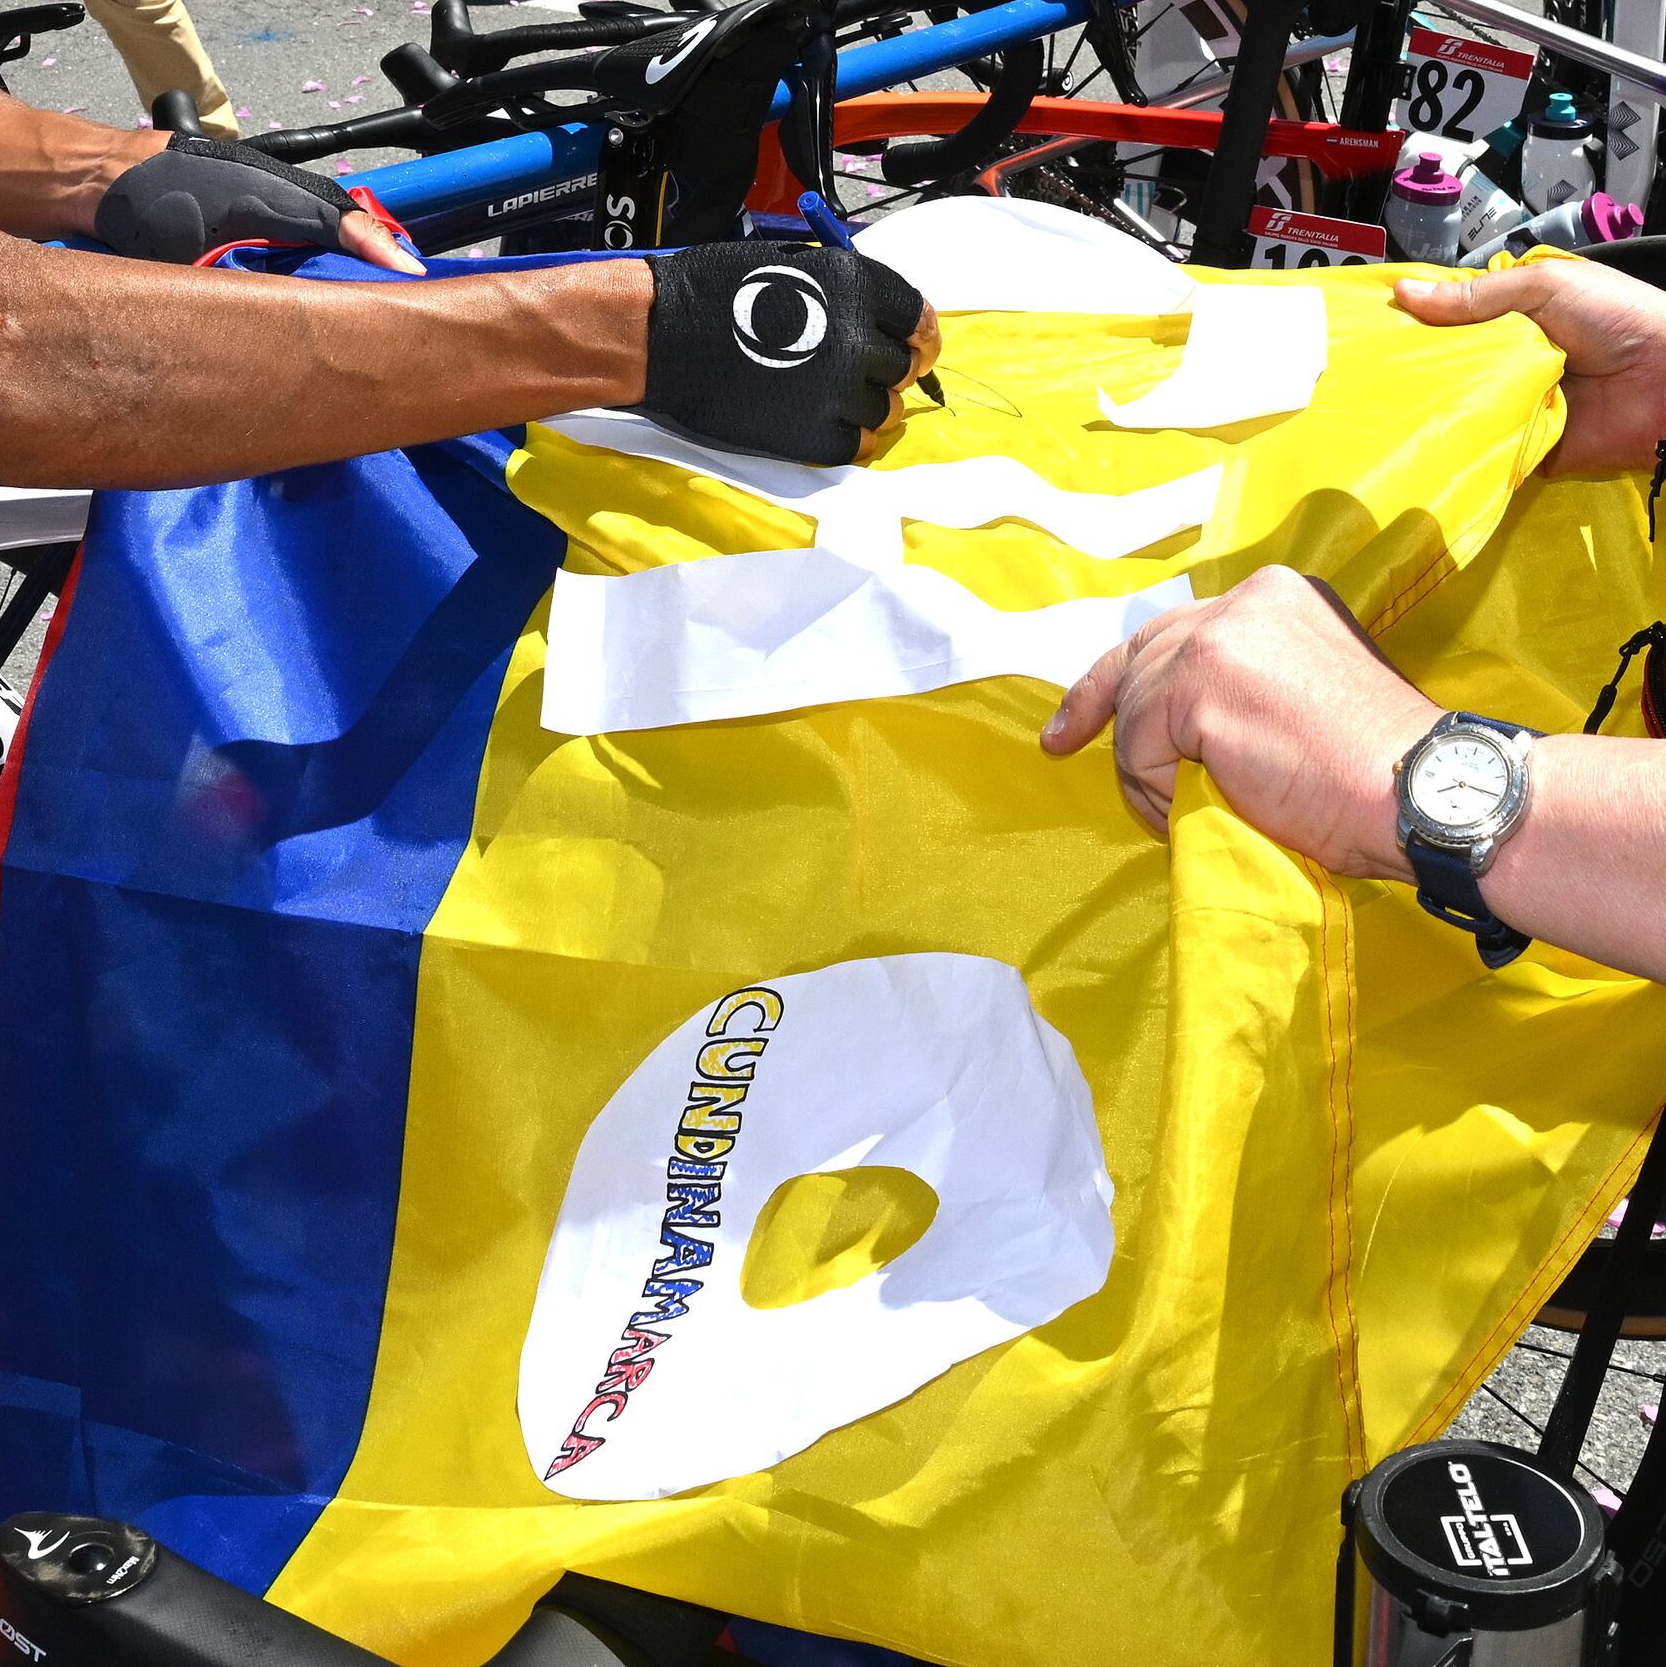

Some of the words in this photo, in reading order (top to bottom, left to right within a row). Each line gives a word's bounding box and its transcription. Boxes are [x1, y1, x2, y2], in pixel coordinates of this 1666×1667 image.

[1457, 50, 1506, 70] TRENITALIA
[1408, 59, 1485, 144] 82
[1339, 136, 1379, 148] ARENSMAN
[487, 171, 598, 218] LAPIERRE
[1286, 226, 1340, 243] TRENITALIA
[543, 985, 785, 1482] CUNDINAMARCA
